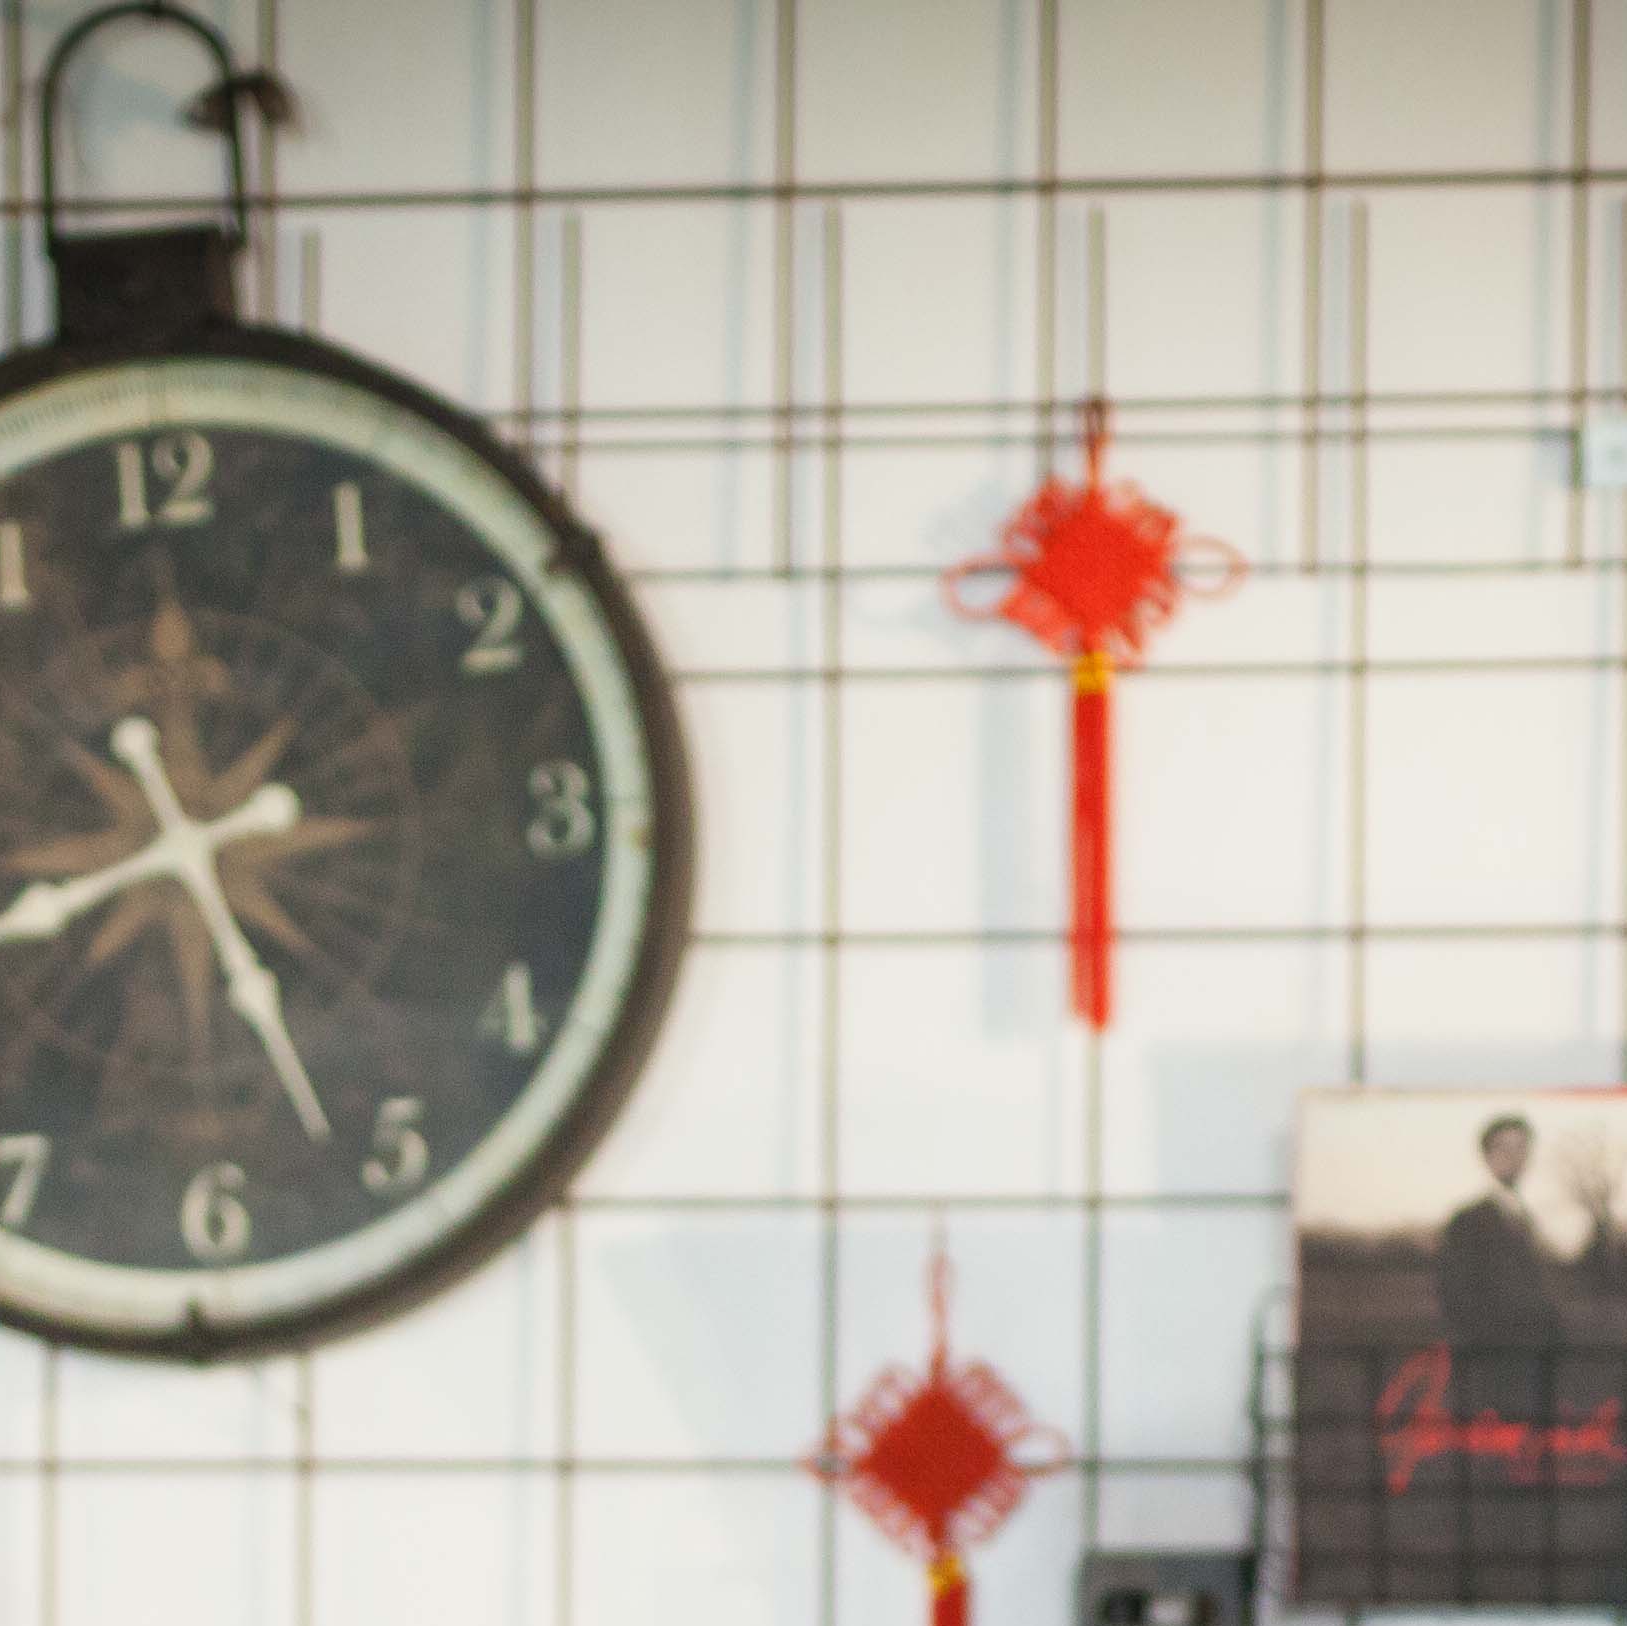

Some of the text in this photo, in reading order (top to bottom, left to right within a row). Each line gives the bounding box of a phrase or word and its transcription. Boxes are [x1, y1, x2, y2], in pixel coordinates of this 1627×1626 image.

[116, 433, 214, 527] 12
[336, 481, 368, 572] 1
[457, 580, 523, 673] 2
[527, 761, 593, 857] 3
[481, 964, 543, 1052] 4
[362, 1098, 428, 1190] 5
[182, 1165, 250, 1260] 6
